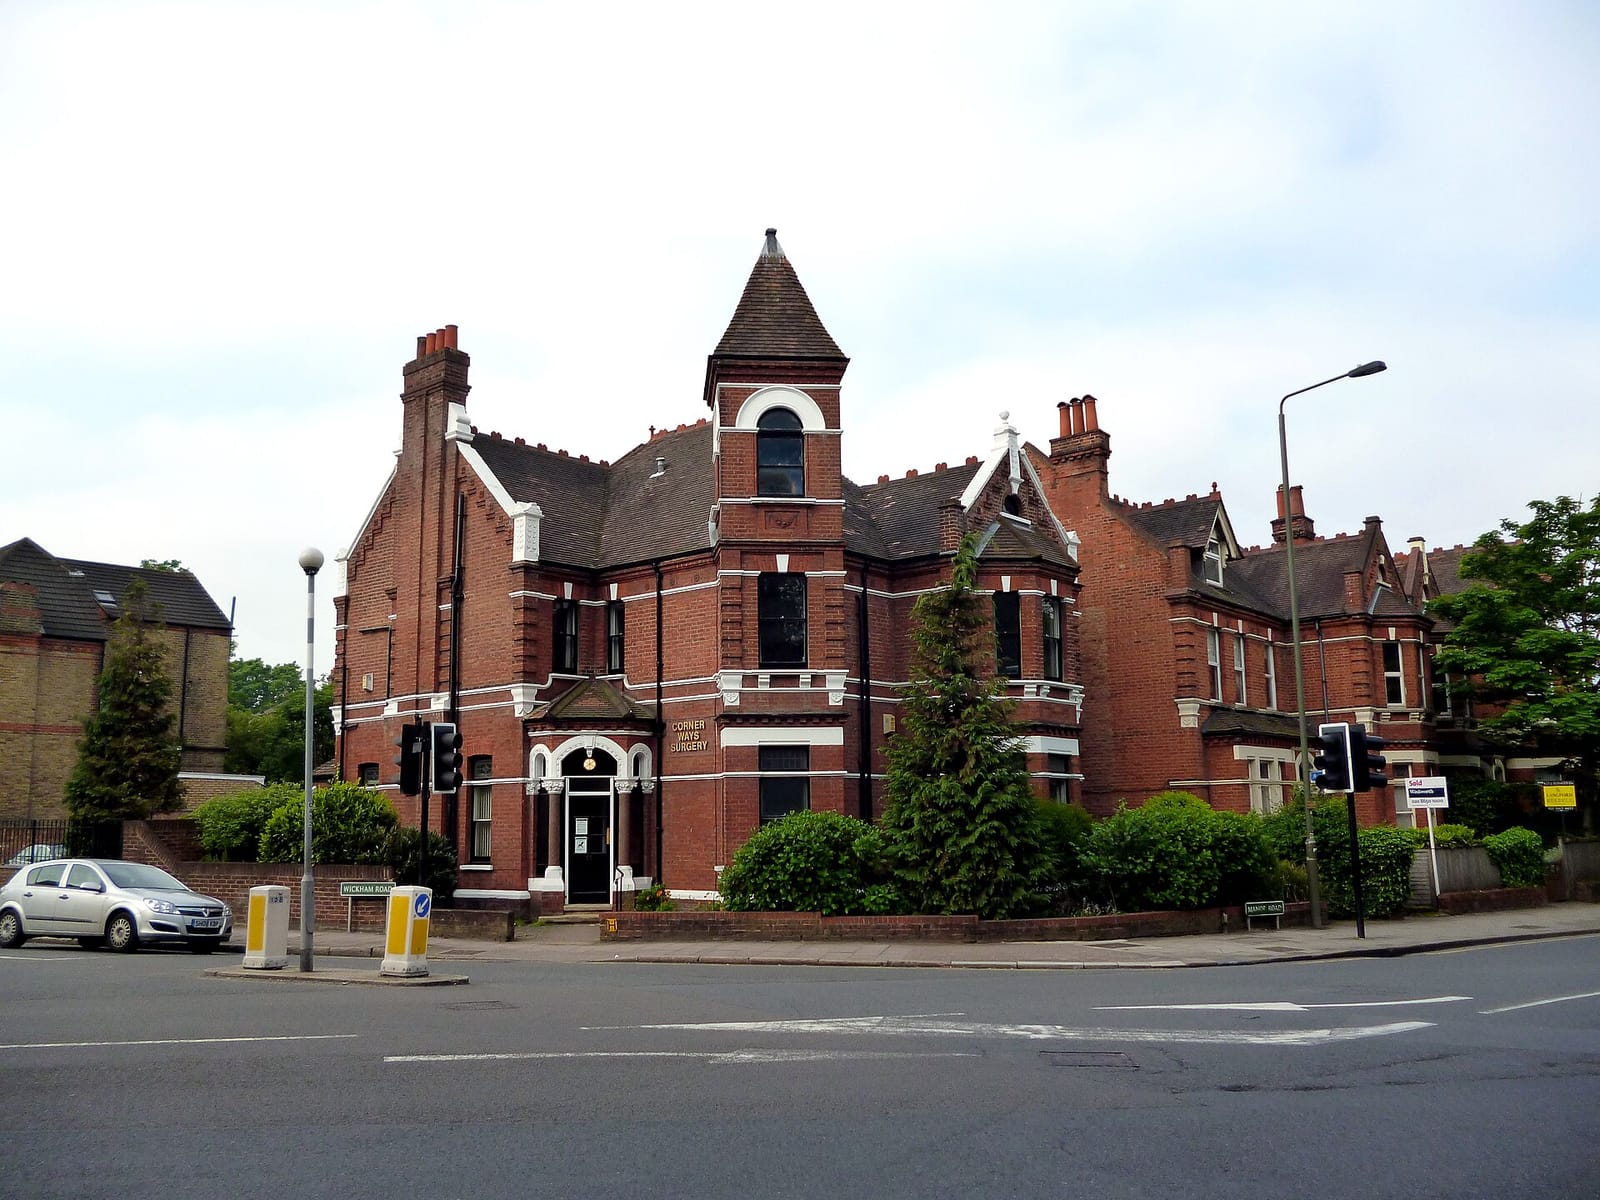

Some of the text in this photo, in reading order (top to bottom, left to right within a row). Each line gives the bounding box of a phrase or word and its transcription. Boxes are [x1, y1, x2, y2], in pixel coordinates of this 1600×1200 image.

[672, 720, 705, 731] CORNER
[677, 731, 699, 741] WAYS
[670, 741, 708, 752] SURGERY
